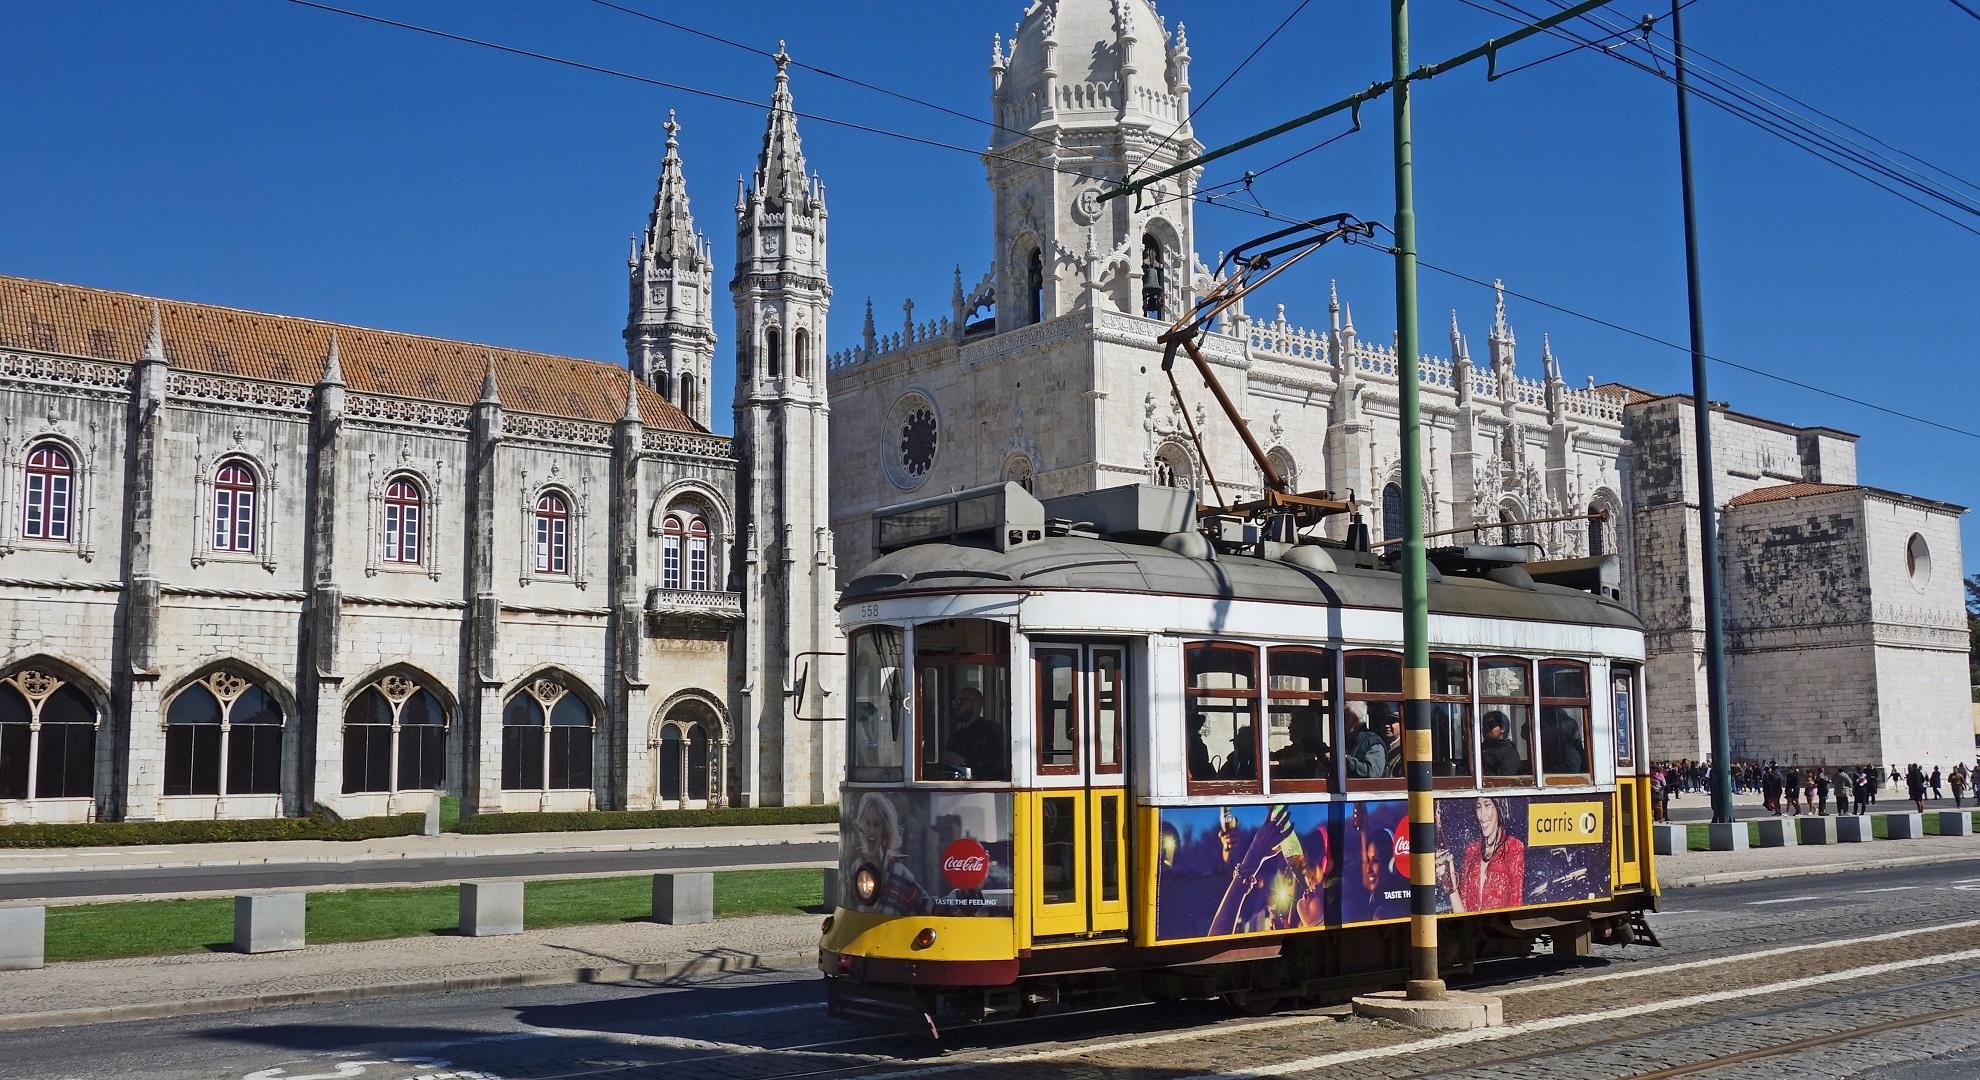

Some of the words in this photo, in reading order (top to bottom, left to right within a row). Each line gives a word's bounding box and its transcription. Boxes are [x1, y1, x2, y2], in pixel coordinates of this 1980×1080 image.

[861, 604, 879, 618] 558
[1536, 811, 1573, 833] carris
[943, 856, 985, 871] Coca-Cola
[968, 898, 997, 906] FEELING
[1383, 891, 1403, 900] TASTE
[1403, 890, 1412, 898] TH
